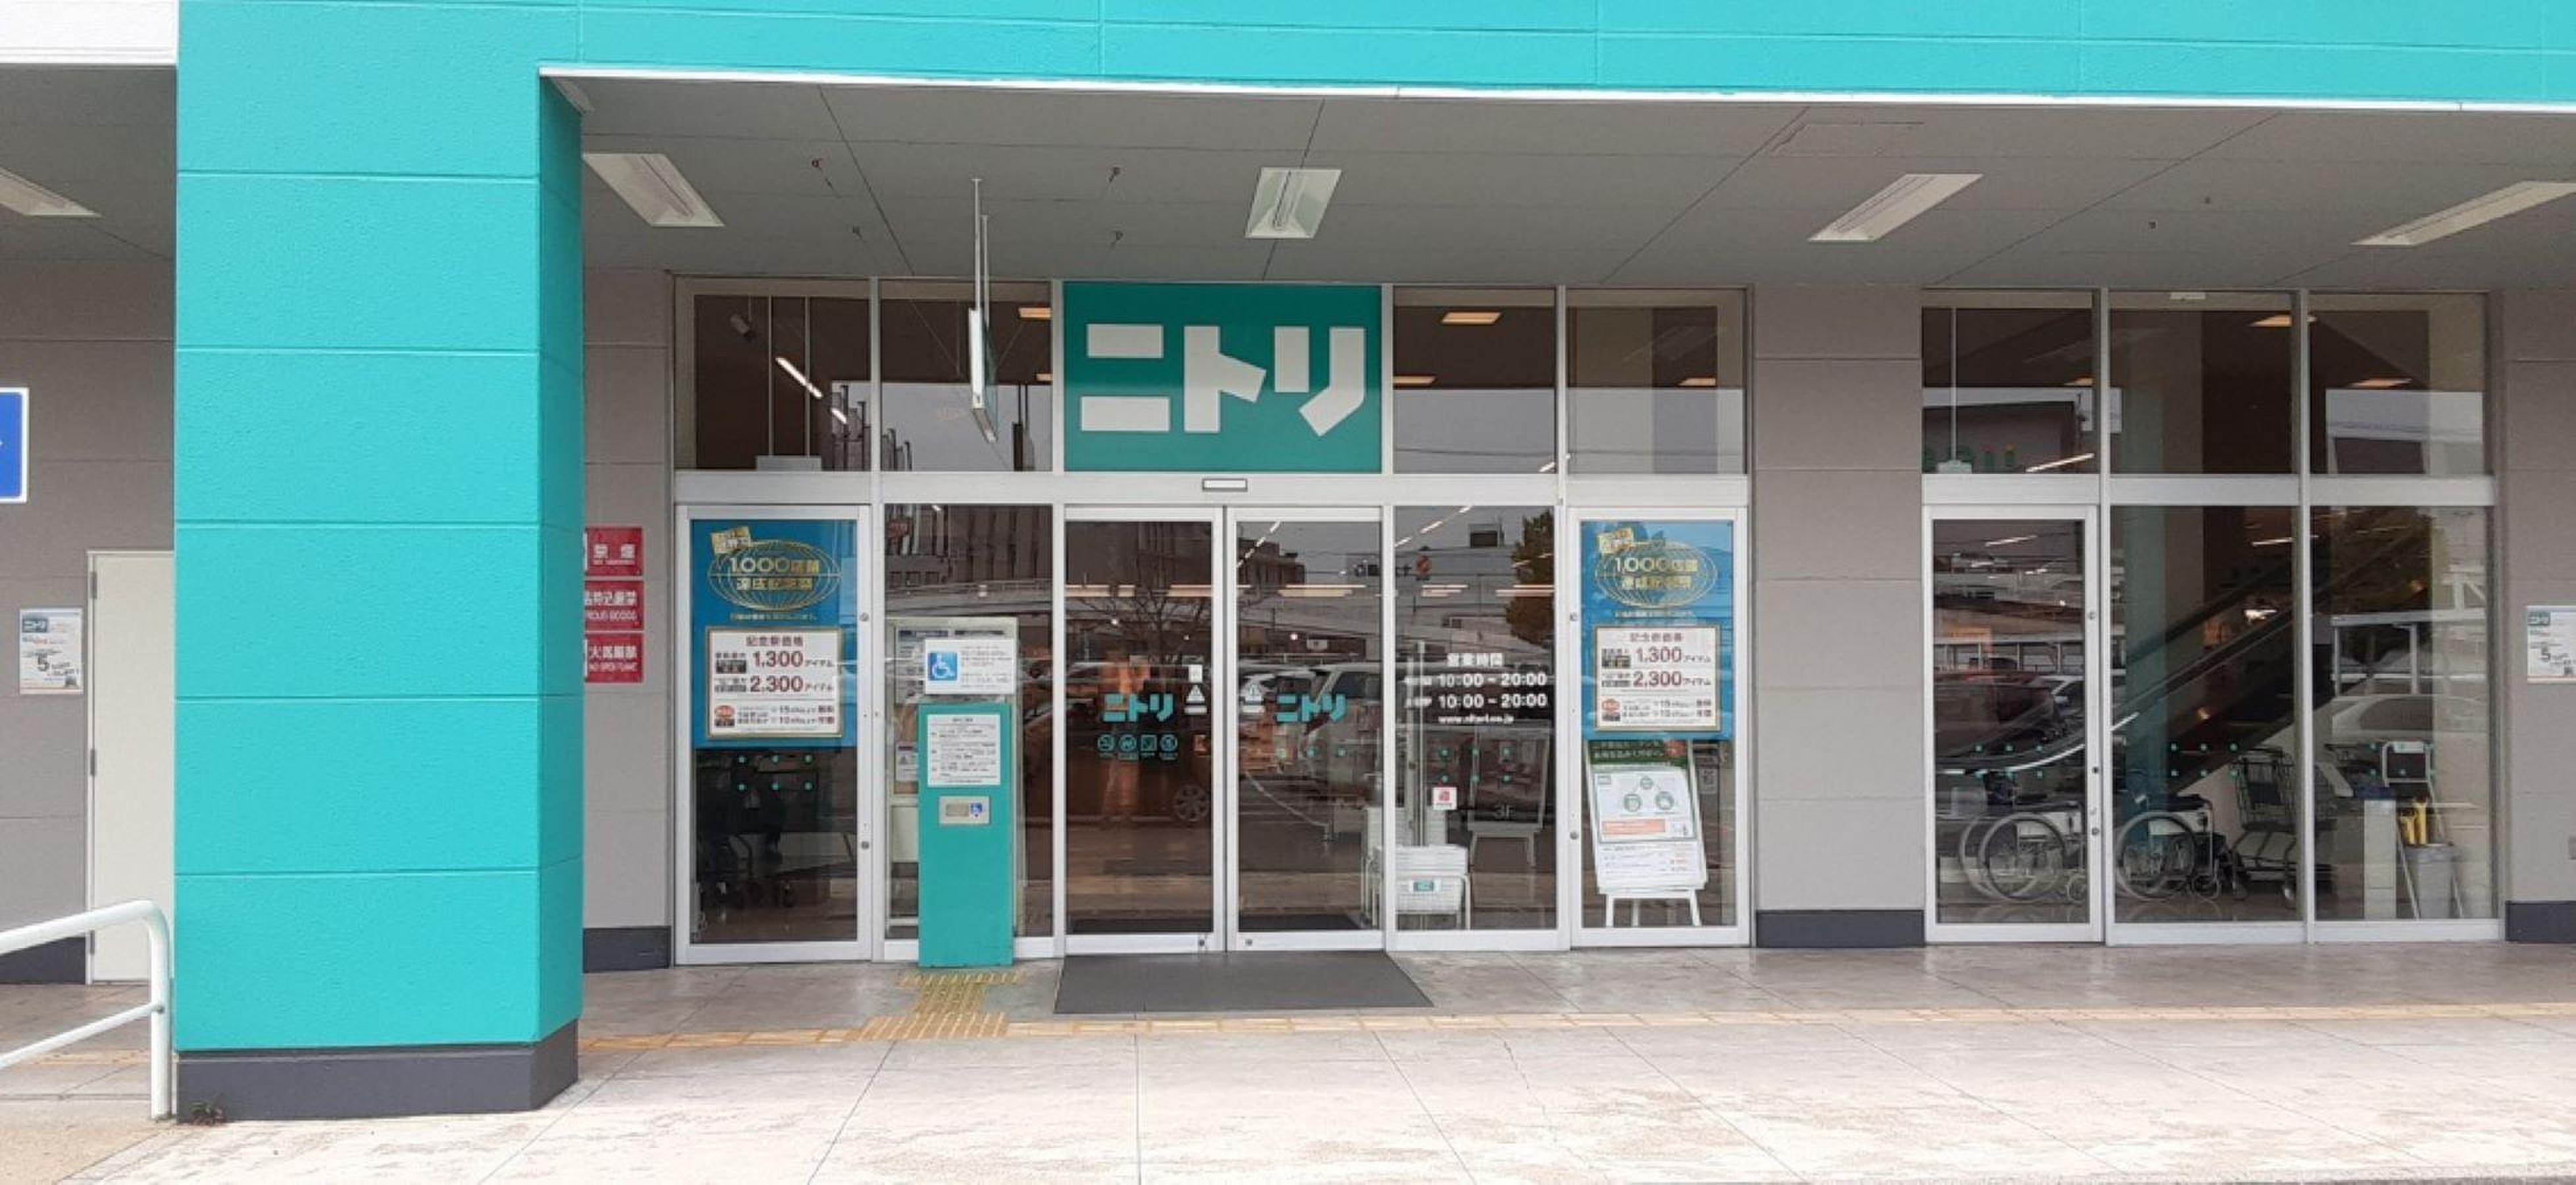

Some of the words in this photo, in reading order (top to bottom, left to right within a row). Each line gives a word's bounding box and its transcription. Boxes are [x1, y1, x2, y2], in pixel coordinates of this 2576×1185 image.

[1081, 324, 1366, 436] ニトリ
[1437, 673, 1484, 687] 10:00
[1501, 672, 1547, 687] 20:00
[1103, 694, 1174, 722] ニトリ
[1275, 694, 1346, 722] ニトリ
[1439, 694, 1484, 708] 10:00
[1501, 693, 1547, 708] 20:00
